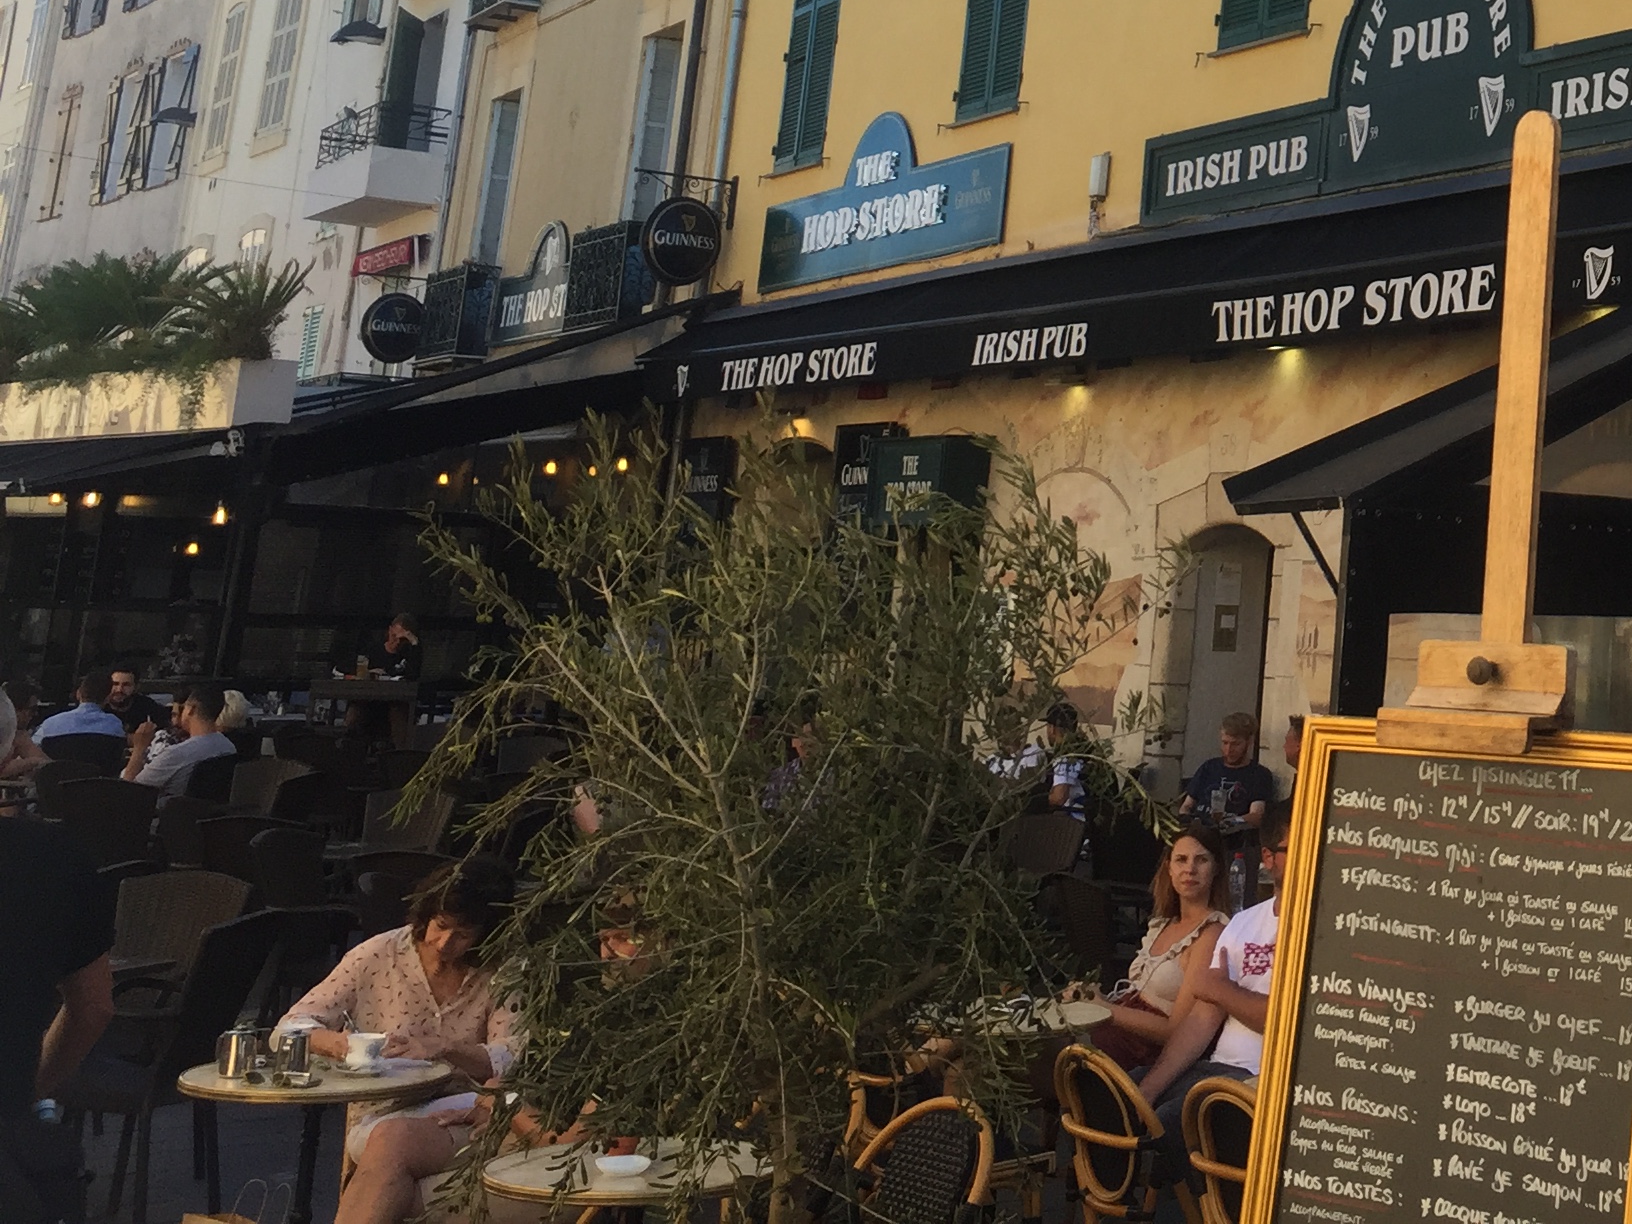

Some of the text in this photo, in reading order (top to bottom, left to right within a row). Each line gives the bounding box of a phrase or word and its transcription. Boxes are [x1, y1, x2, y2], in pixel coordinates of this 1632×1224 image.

[1390, 11, 1469, 69] PUB
[856, 151, 899, 187] THE
[1165, 135, 1308, 197] IRISH PUB
[654, 229, 715, 251] GUINNESS
[801, 184, 949, 254] HOP STORE
[500, 292, 523, 328] THE
[522, 287, 549, 324] HOP
[1211, 263, 1496, 343] THE HOP STORE
[721, 341, 878, 391] THE HOP STORE
[971, 322, 1088, 366] IRISH PUB
[902, 456, 919, 475] THE
[1419, 761, 1464, 787] CHEZ
